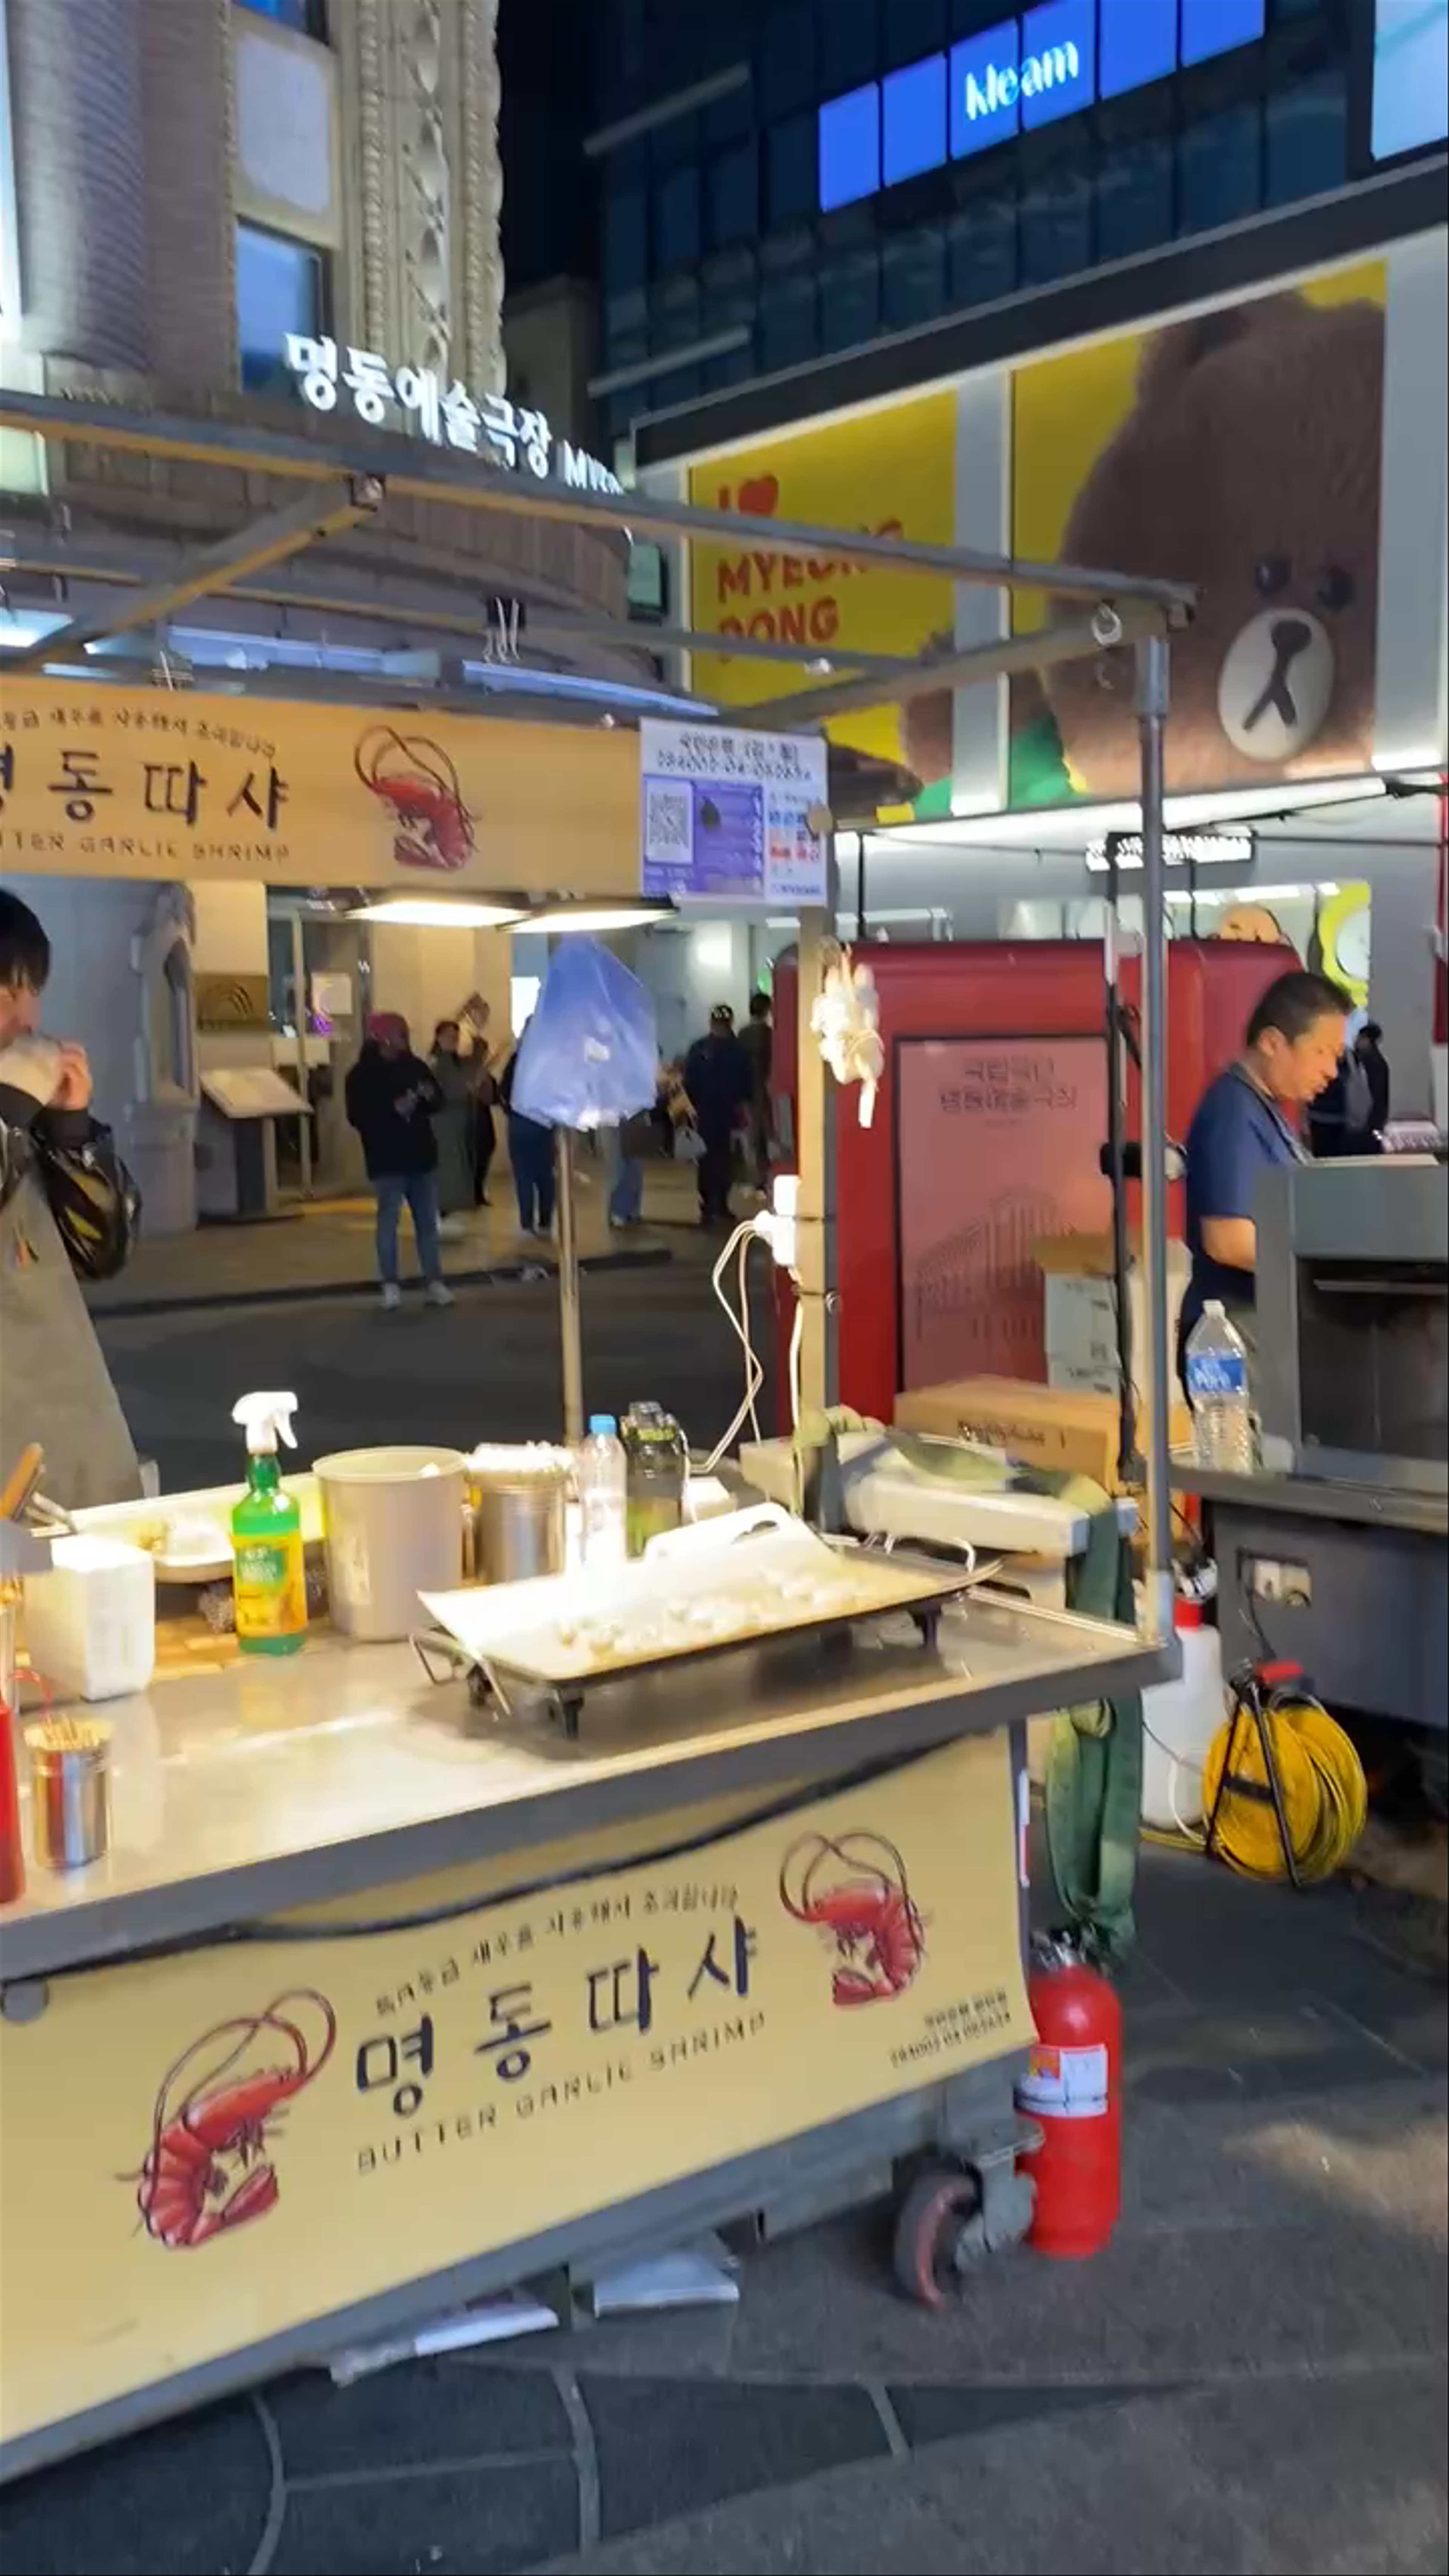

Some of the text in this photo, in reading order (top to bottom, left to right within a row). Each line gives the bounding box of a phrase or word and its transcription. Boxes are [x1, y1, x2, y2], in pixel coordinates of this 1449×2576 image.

[284, 333, 552, 479] 명동예술극장
[80, 835, 177, 858] GARLIC
[192, 842, 290, 864] SHRIMP
[357, 2011, 766, 2176] BUTTER GARLIC SHRIMP
